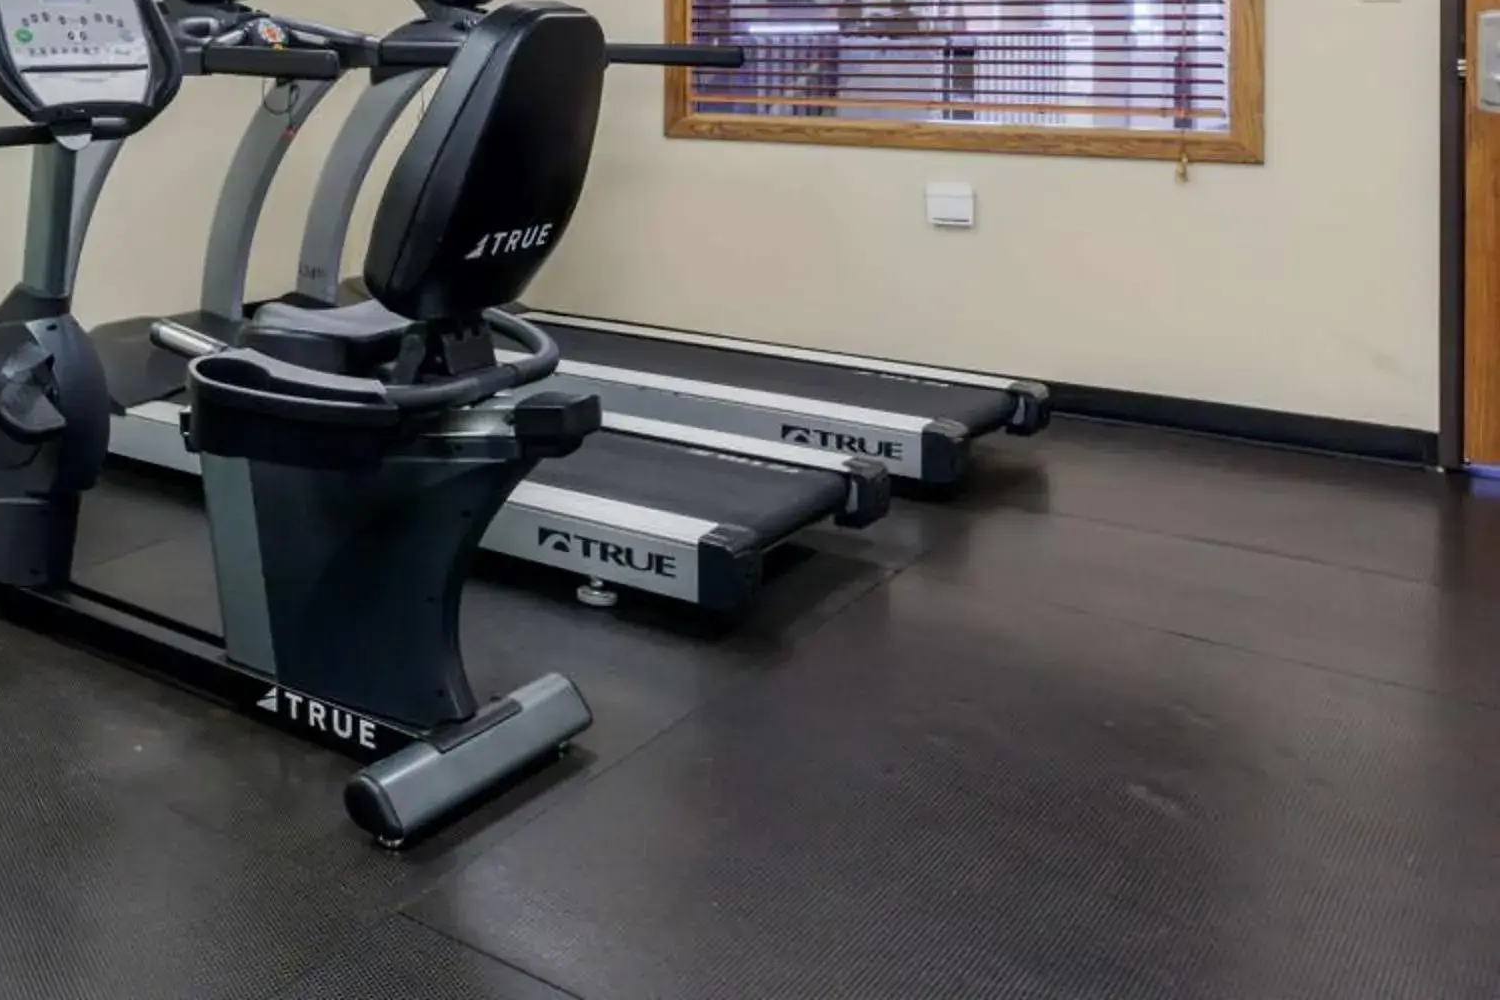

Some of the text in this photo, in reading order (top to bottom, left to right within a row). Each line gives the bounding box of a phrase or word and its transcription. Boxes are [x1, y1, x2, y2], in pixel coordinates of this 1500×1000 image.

[491, 223, 553, 256] TRUE
[812, 428, 904, 461] TRUE
[573, 533, 677, 579] TRUE
[283, 691, 377, 750] TRUE
